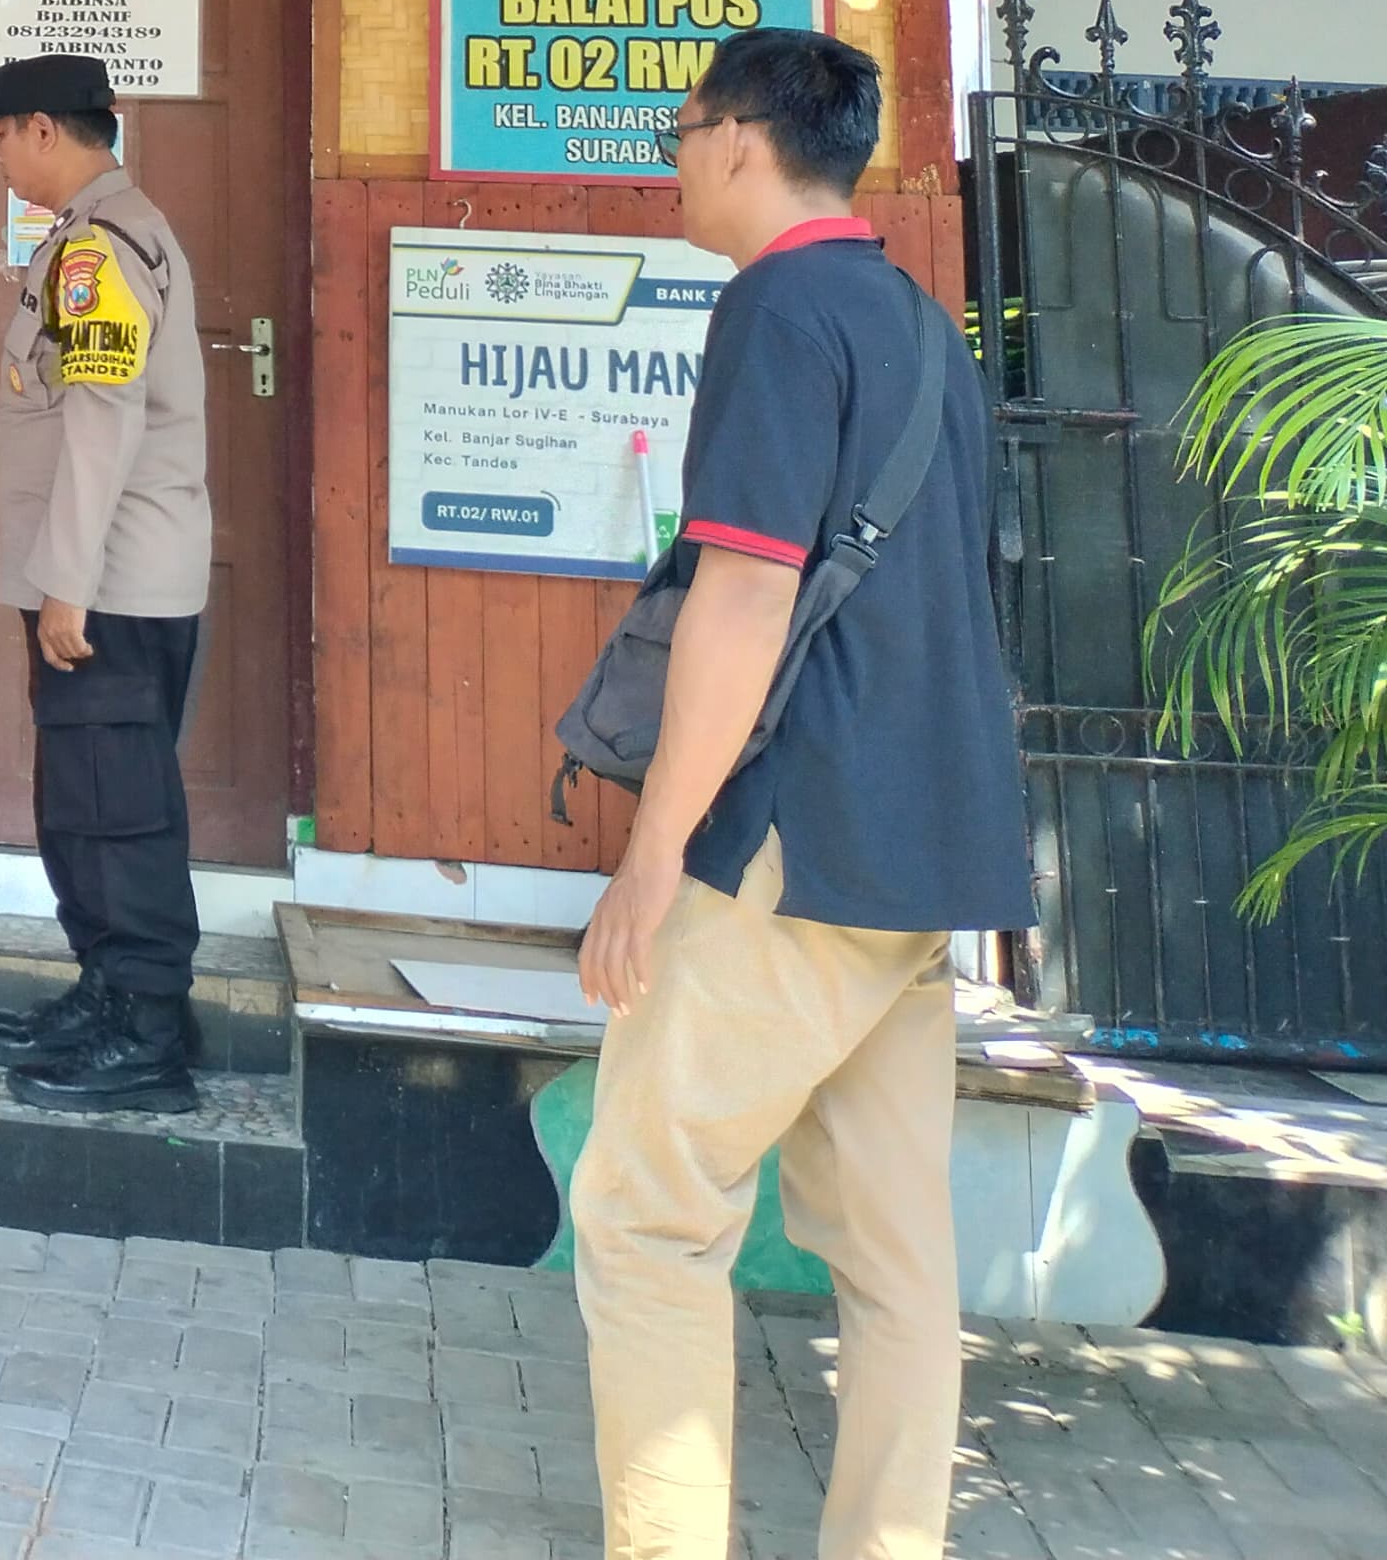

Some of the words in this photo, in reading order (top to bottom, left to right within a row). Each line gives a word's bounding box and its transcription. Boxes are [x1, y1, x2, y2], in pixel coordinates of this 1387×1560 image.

[6, 26, 162, 39] 081232943189
[40, 42, 127, 54] BABINAS
[466, 36, 541, 89] RT.
[548, 36, 619, 90] 02
[494, 104, 547, 128] KEL.
[406, 268, 438, 282] PLN
[406, 279, 470, 301] Peduli
[535, 279, 560, 289] Bina
[564, 280, 603, 291] Bhakti
[534, 288, 609, 301] Lingkungan
[656, 288, 705, 302] BANK
[460, 342, 589, 399] HIJAU
[423, 403, 497, 418] Manukan
[502, 407, 529, 419] Lor
[591, 411, 669, 428] Surabaya
[462, 432, 509, 447] Banjar
[515, 435, 577, 450] Sugihan
[462, 455, 518, 469] Tandes
[491, 507, 540, 524] RW.01
